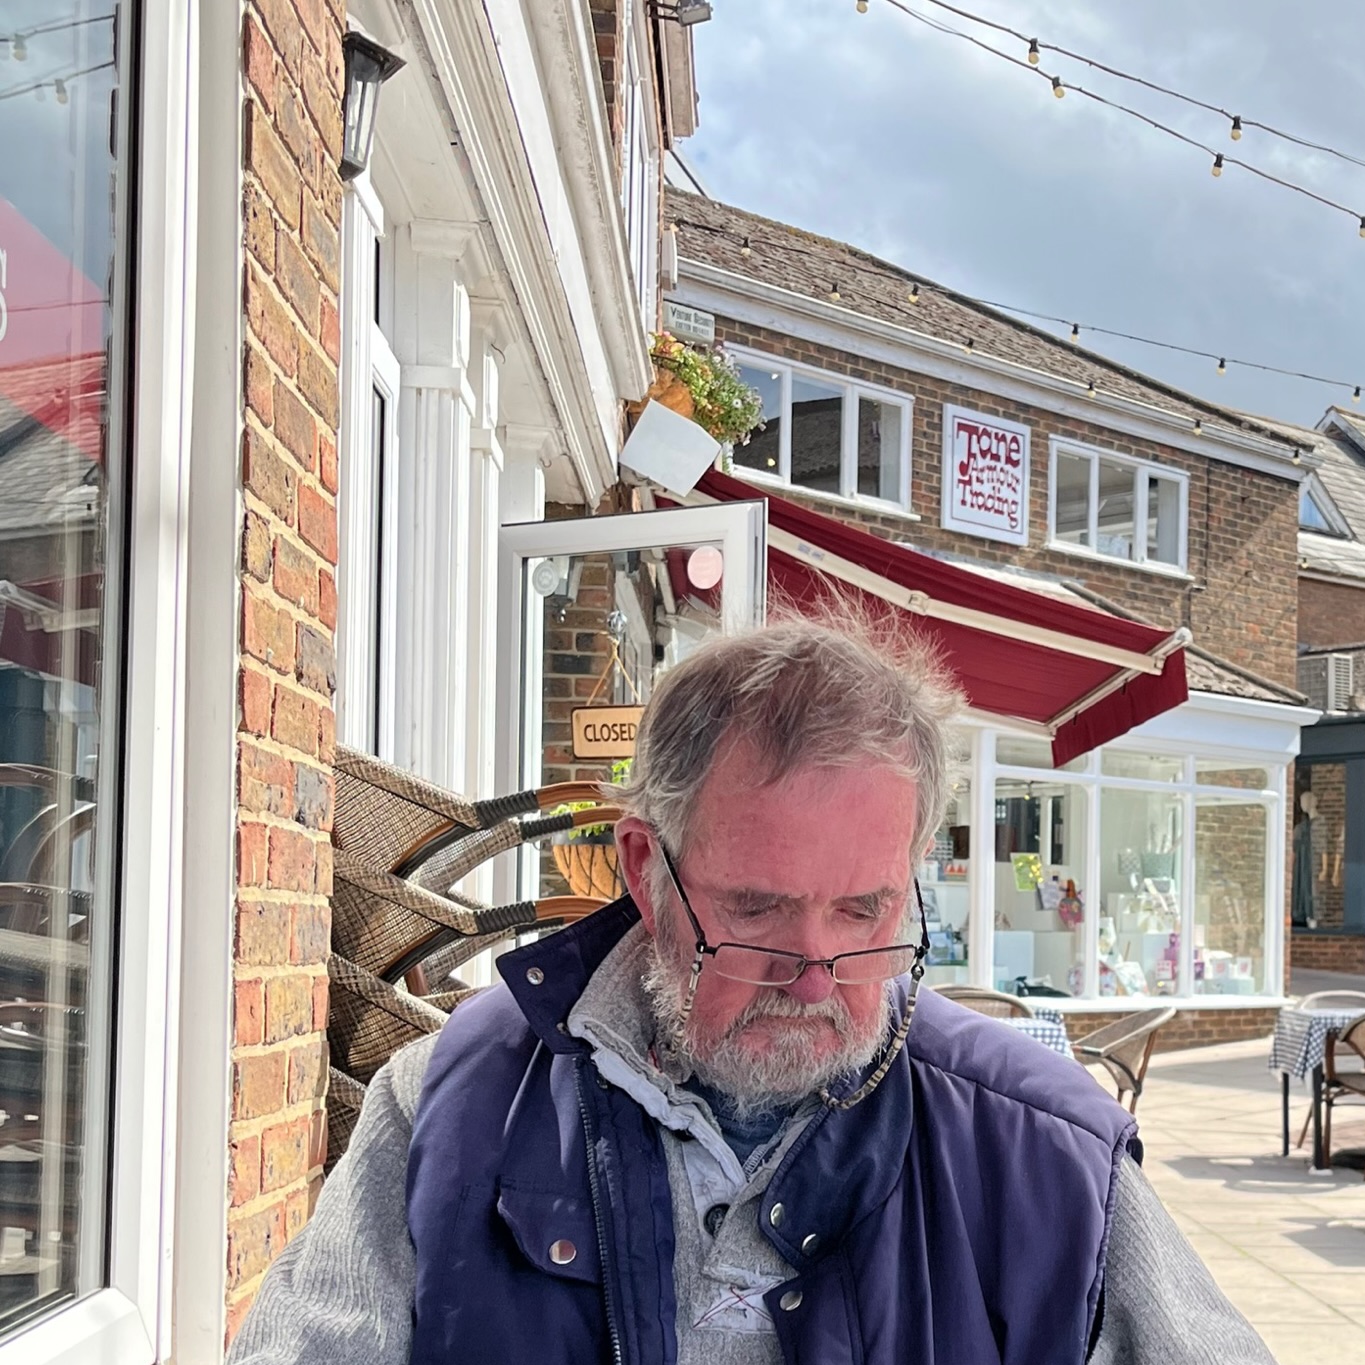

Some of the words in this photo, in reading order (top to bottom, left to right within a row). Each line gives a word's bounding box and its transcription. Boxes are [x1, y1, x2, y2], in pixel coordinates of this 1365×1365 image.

[957, 422, 1020, 477] Jane
[970, 453, 1019, 493] Armour
[957, 477, 1018, 529] Trading
[584, 723, 638, 742] CLOSED
